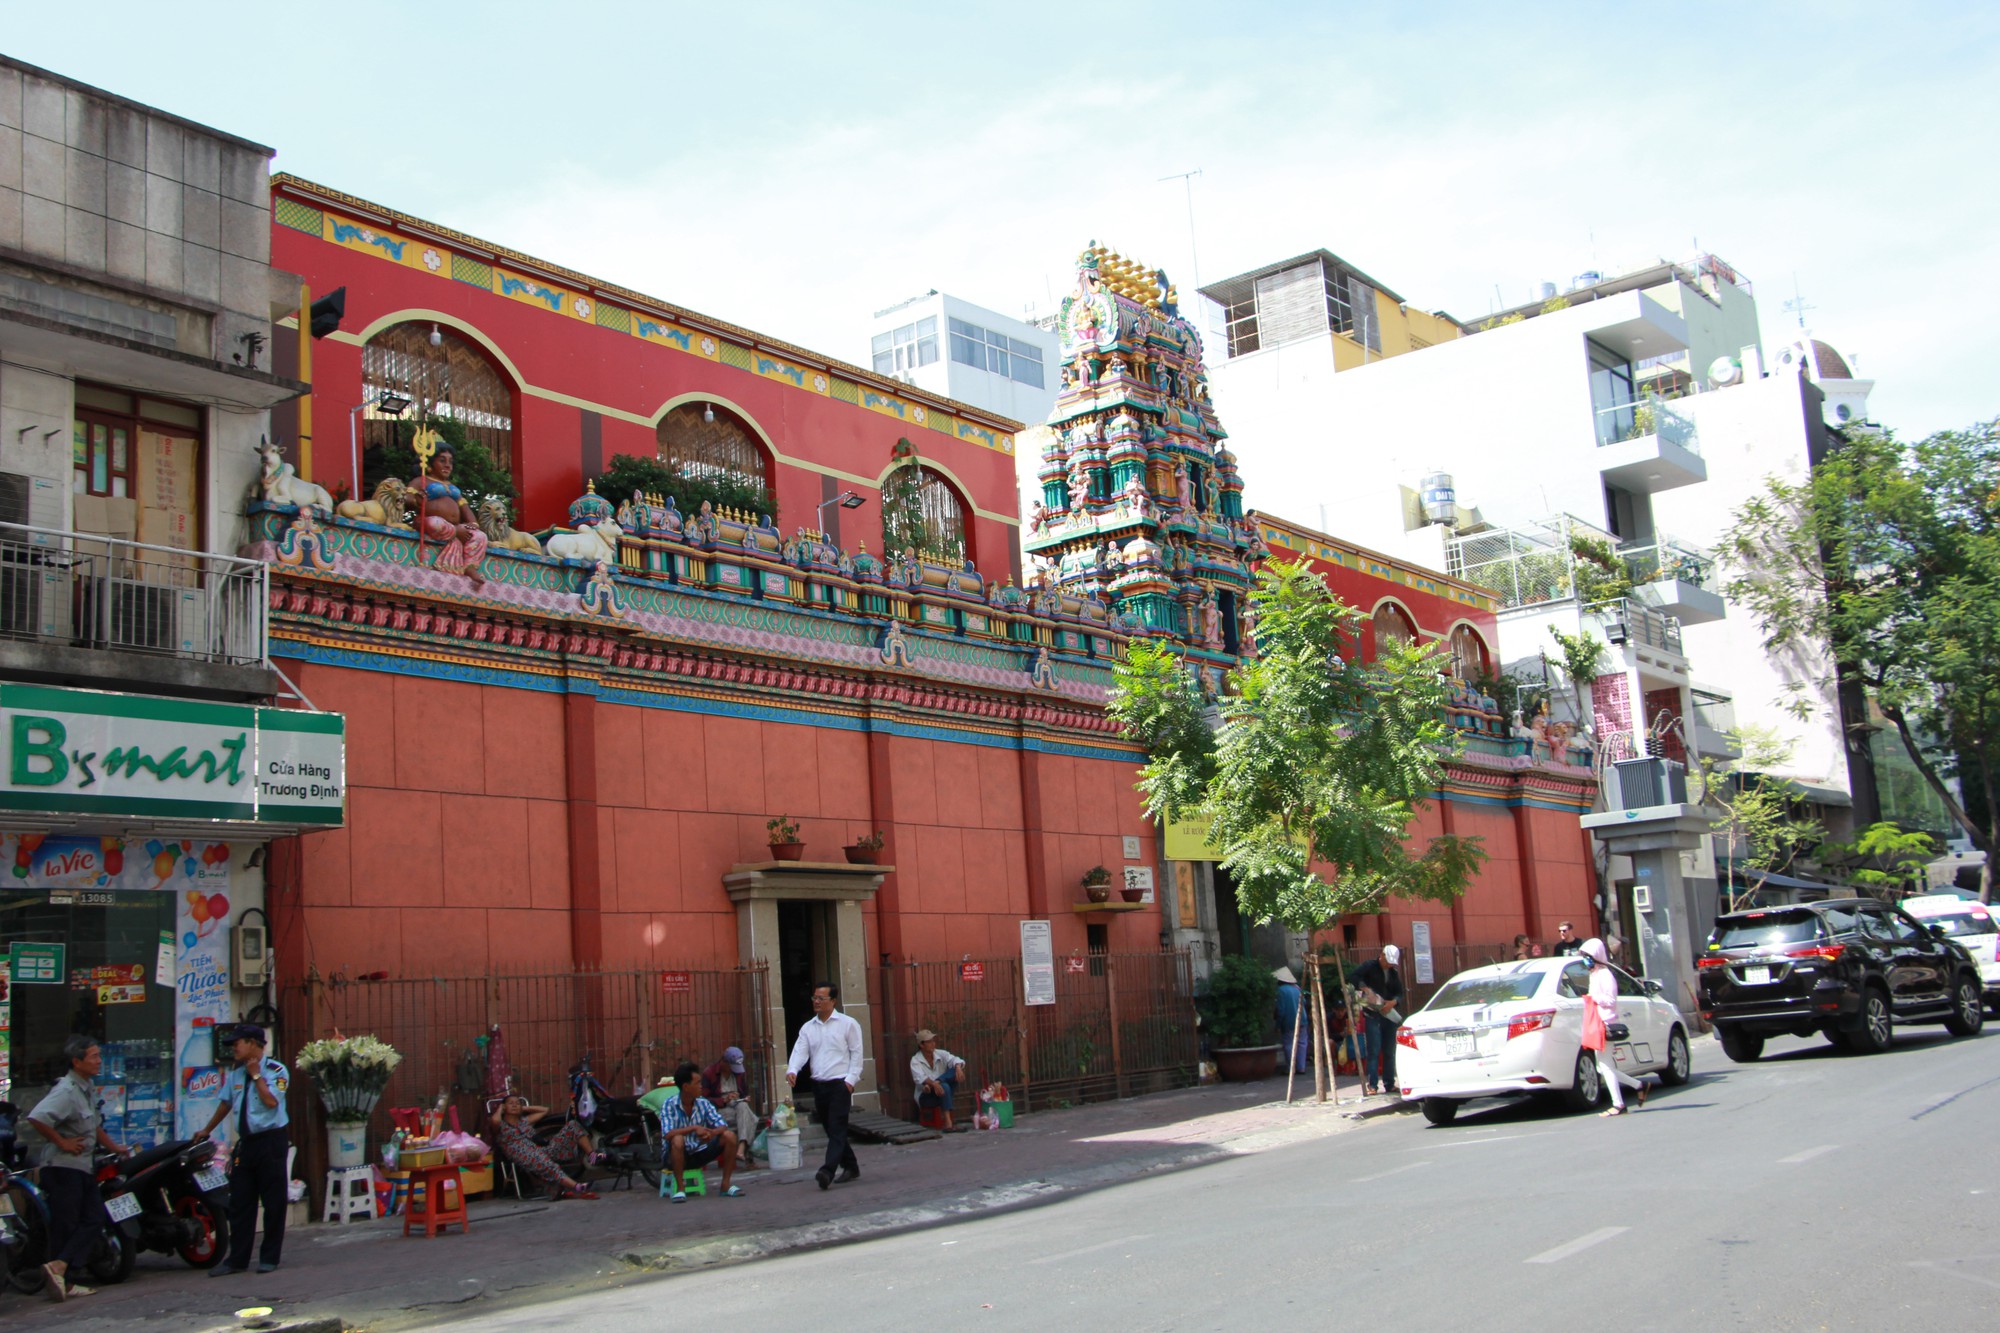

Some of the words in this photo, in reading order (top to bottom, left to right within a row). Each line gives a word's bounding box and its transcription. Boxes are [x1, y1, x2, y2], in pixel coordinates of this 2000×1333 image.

[269, 760, 295, 776] Cửa
[298, 763, 331, 781] Hàng
[261, 782, 307, 799] Trương
[310, 784, 339, 801] Định
[80, 893, 113, 904] 13085
[177, 971, 228, 993] Nước
